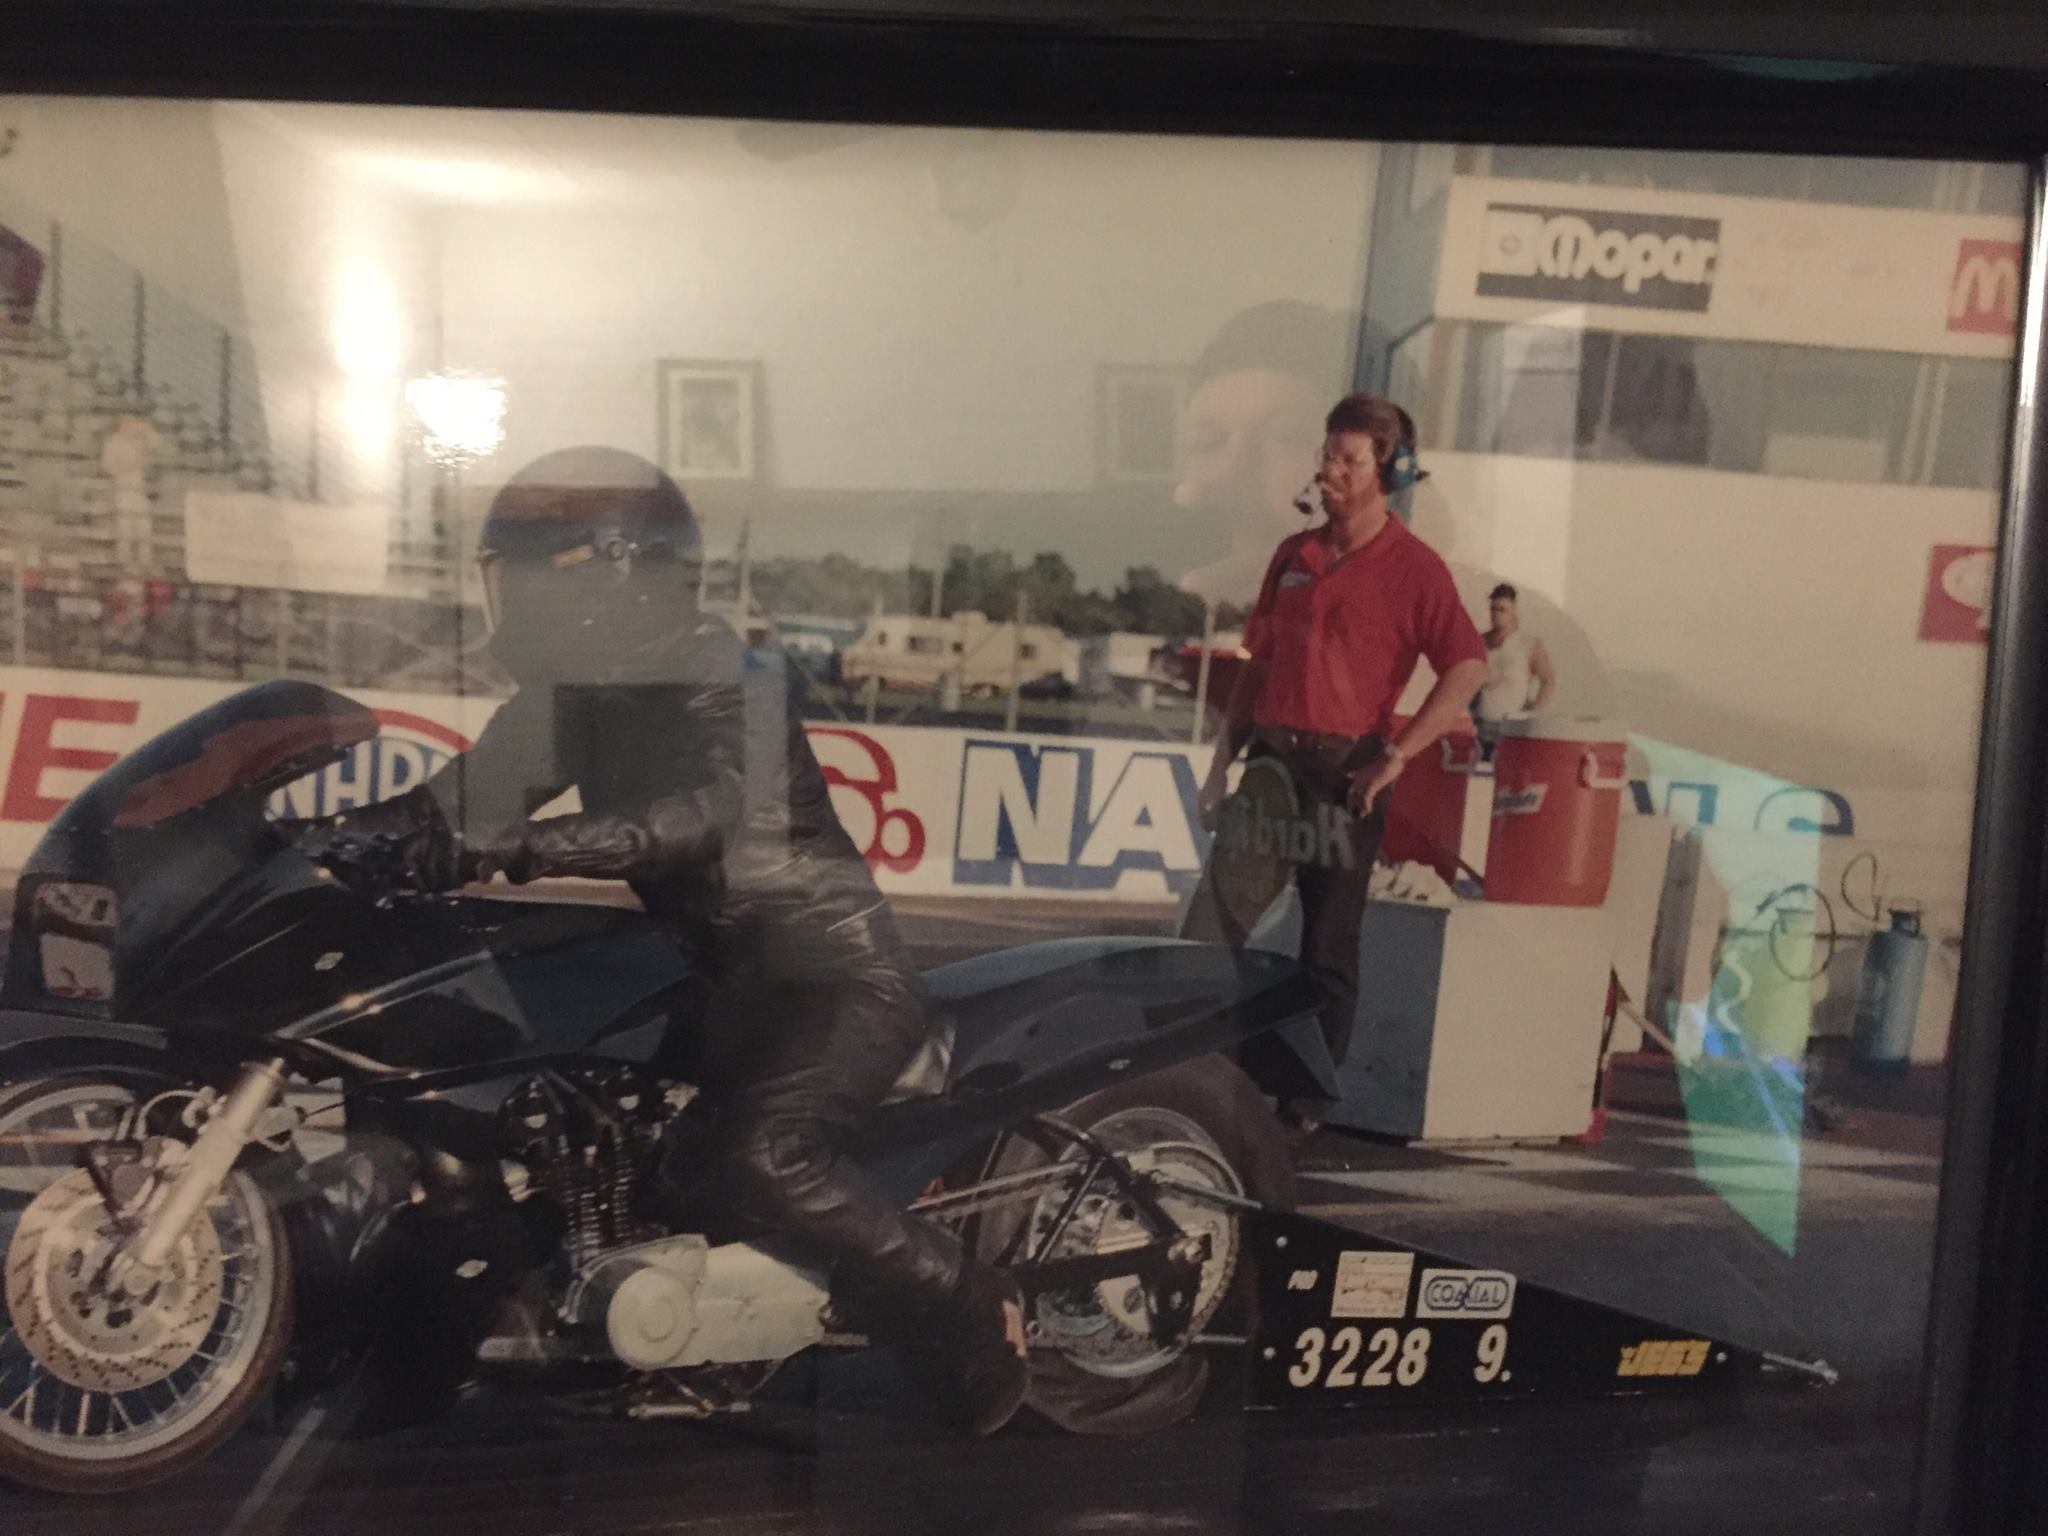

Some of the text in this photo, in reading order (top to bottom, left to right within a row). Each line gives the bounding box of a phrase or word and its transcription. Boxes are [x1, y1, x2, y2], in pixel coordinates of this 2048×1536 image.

[1534, 213, 1720, 294] Mopar
[1287, 1323, 1512, 1388] 3228 9.
